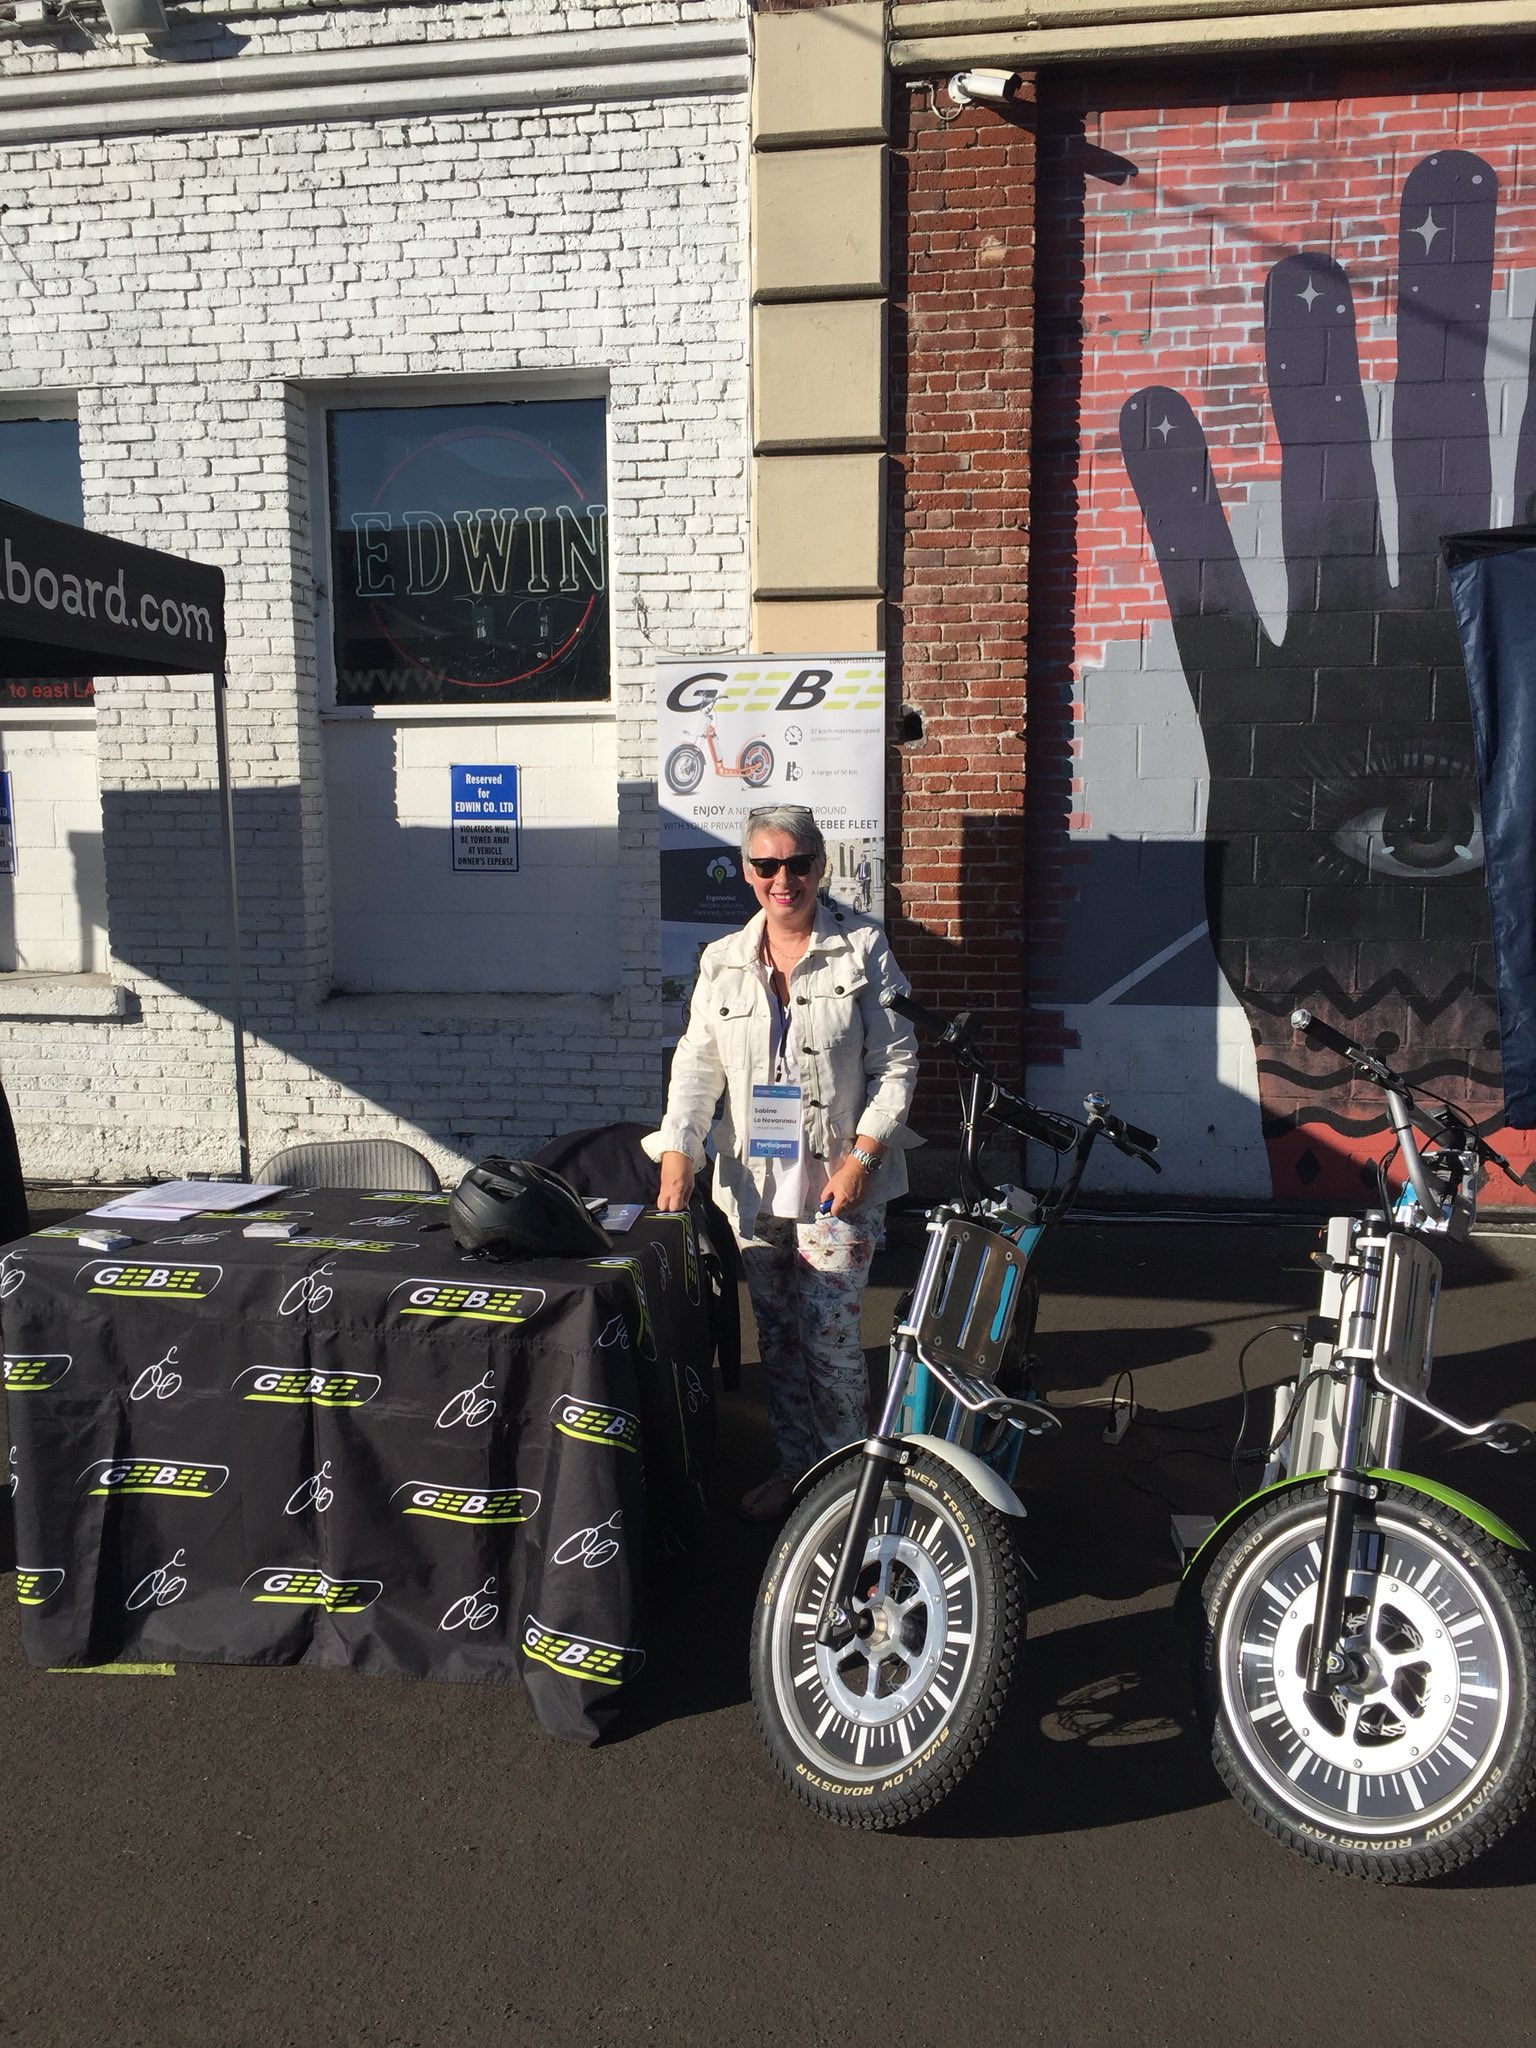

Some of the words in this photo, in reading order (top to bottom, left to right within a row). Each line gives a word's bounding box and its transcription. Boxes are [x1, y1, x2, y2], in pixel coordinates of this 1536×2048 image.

[351, 504, 606, 597] EDWIN
[0, 538, 214, 643] board.com
[9, 682, 27, 698] to
[32, 682, 70, 698] east
[863, 728, 880, 736] speed
[465, 773, 503, 785] Reserved
[477, 788, 491, 799] for
[455, 801, 481, 813] EDWIN
[483, 801, 498, 813] CO.
[499, 801, 514, 813] LTD
[693, 806, 726, 817] ENJOY
[460, 825, 493, 834] VIOLATORS
[494, 825, 510, 834] WILL
[663, 821, 683, 830] WITH
[686, 821, 709, 830] YOUR
[848, 819, 879, 829] FLEET
[460, 836, 469, 844] BE
[470, 836, 492, 844] TOWED
[493, 836, 511, 844] AWAY
[468, 847, 475, 855] AT
[477, 847, 503, 855] VEHICLE
[457, 857, 486, 866] OWNER'S
[487, 857, 514, 866] EXPENSE
[756, 1141, 792, 1150] Participant
[903, 1465, 939, 1490] OWER
[942, 1490, 977, 1549] TREAD
[1219, 1531, 1264, 1590] TREAD
[881, 1725, 950, 1792] SWALLOW
[795, 1762, 875, 1797] ROADSTAR
[1425, 1765, 1503, 1842] SWALLOW
[1297, 1821, 1413, 1851] ROADSTAR
